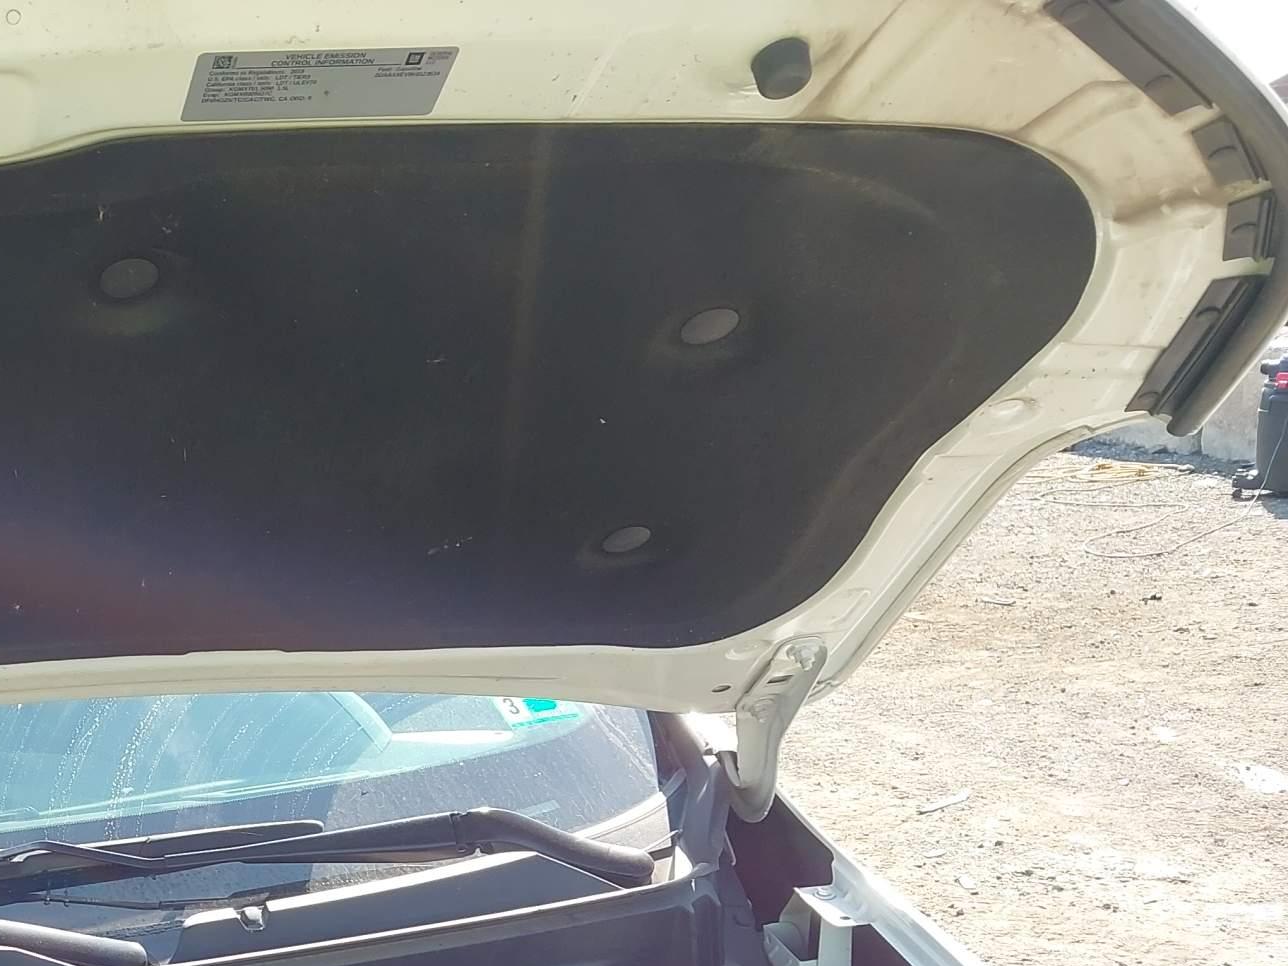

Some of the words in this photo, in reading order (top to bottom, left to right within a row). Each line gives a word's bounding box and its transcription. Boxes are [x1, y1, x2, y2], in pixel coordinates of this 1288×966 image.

[323, 52, 368, 60] EMISSION
[271, 59, 313, 67] CONTROL
[502, 697, 521, 715] 3
